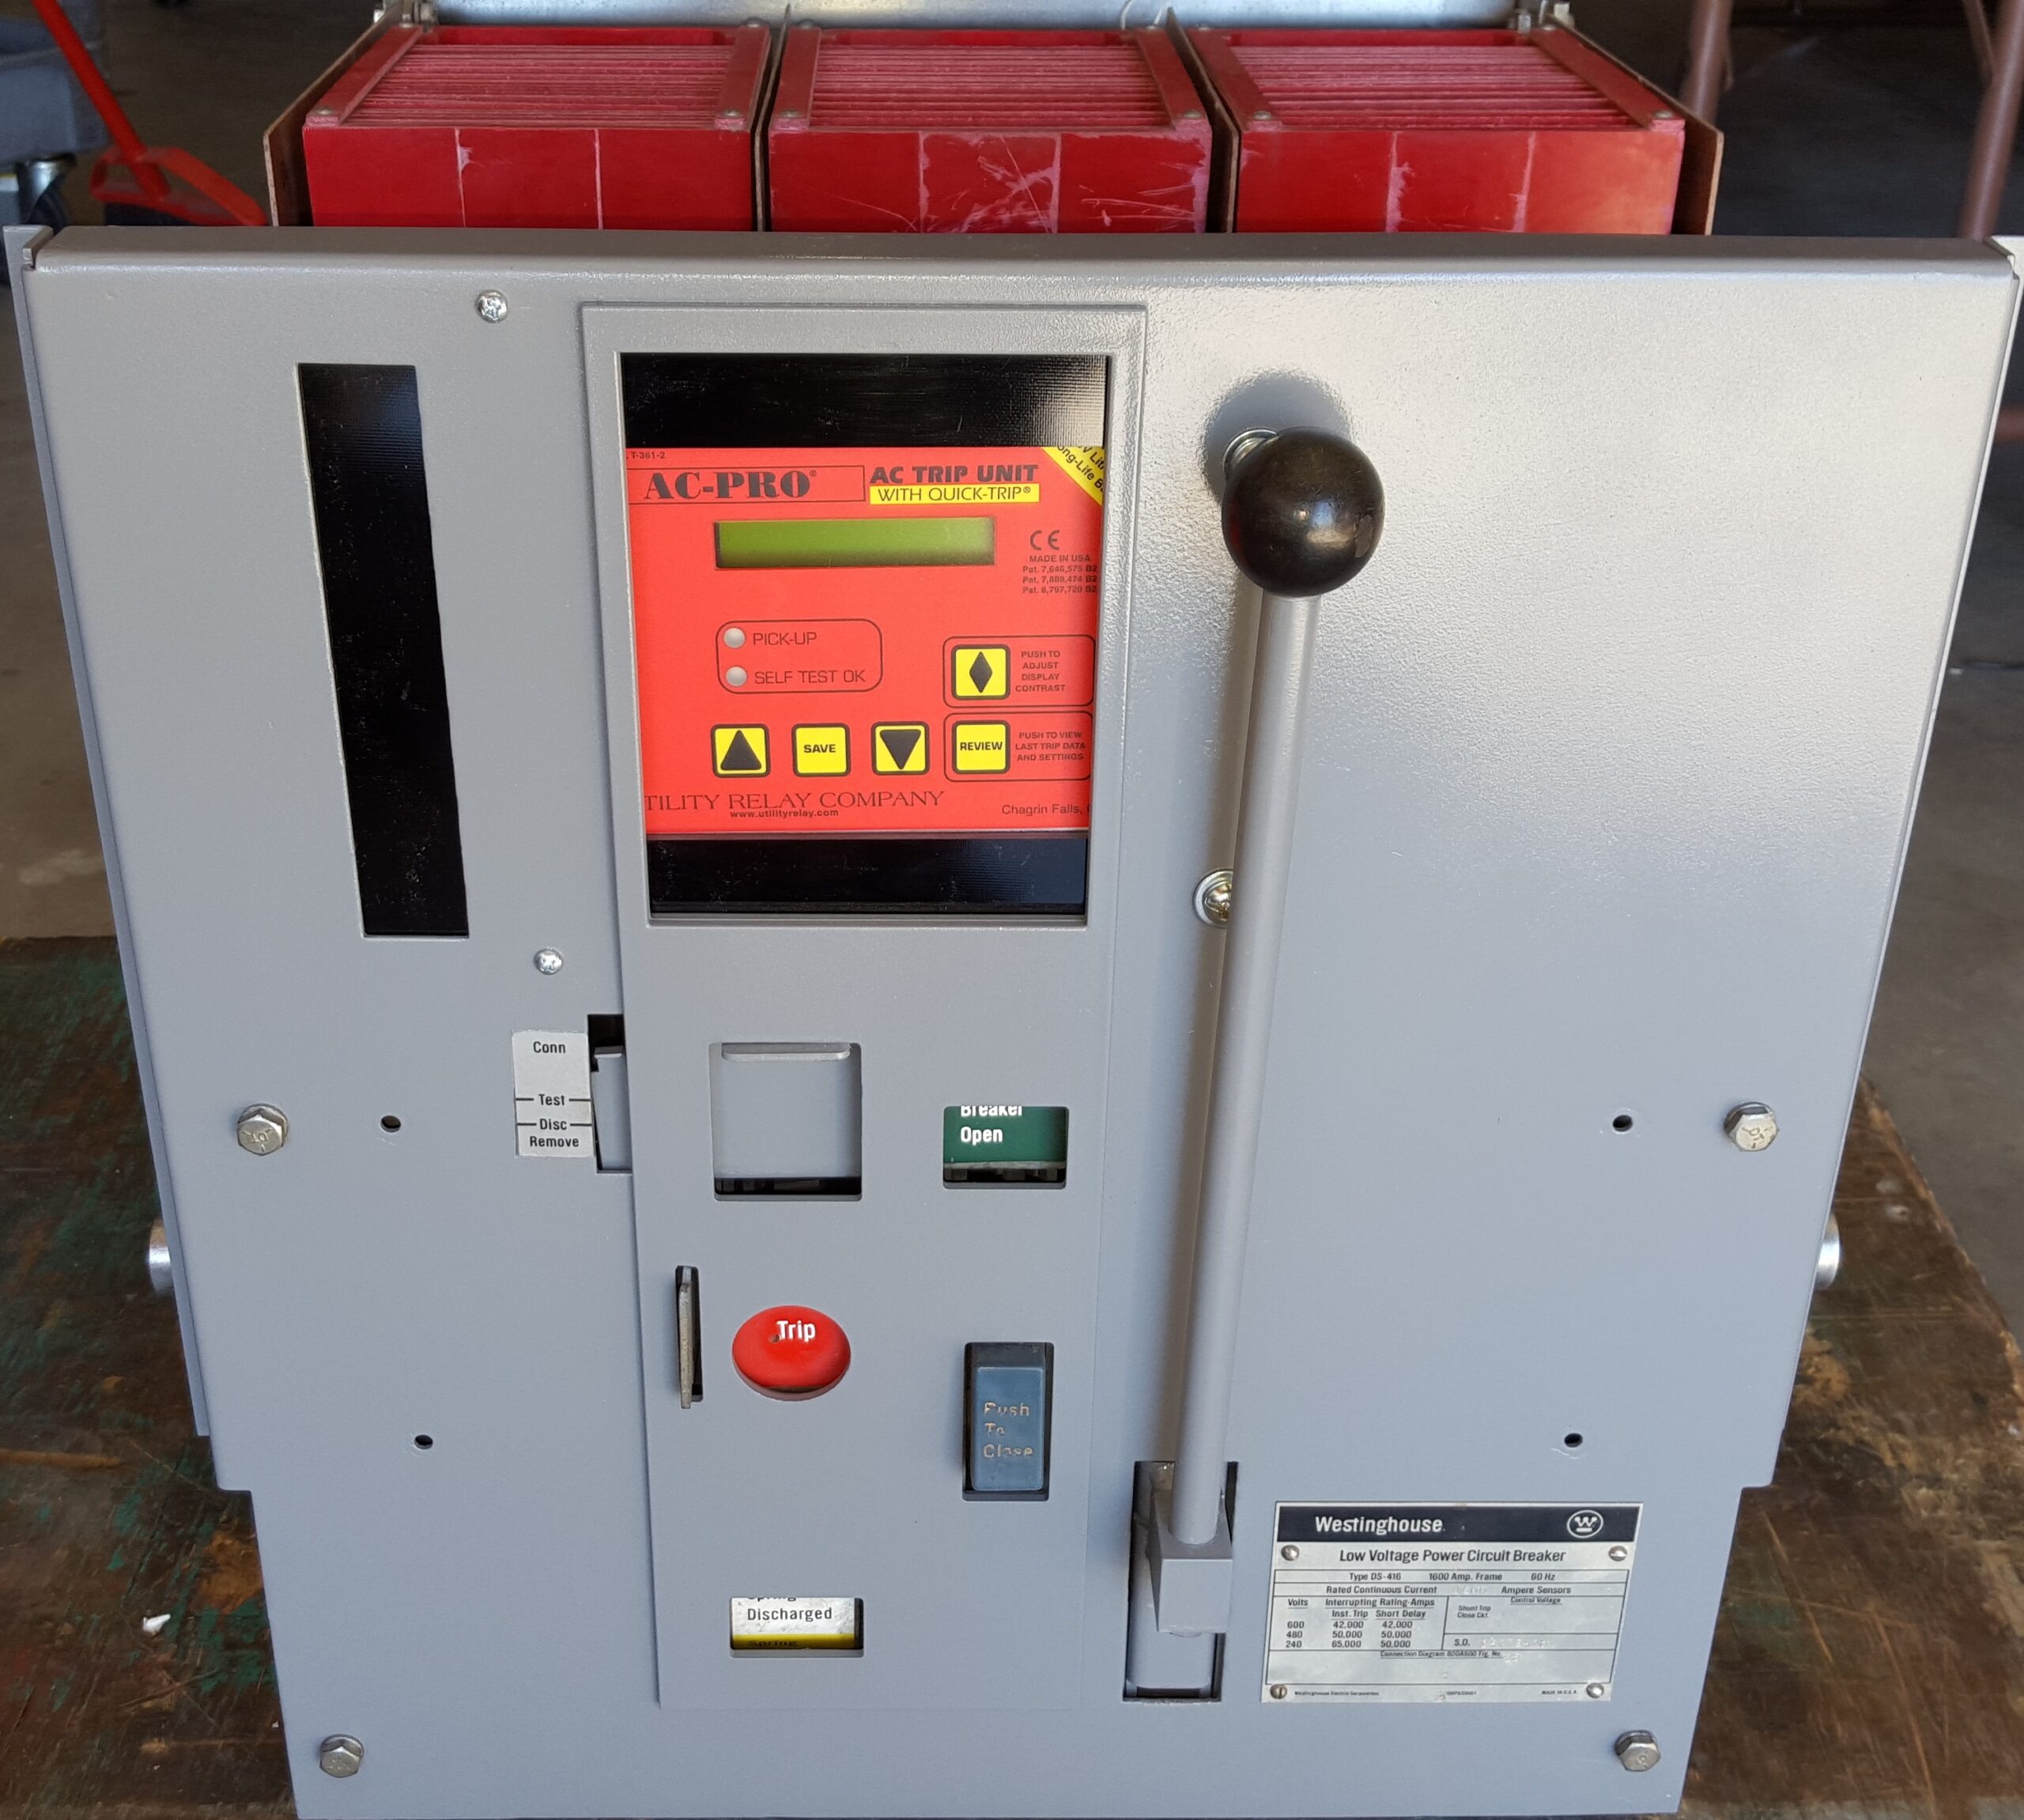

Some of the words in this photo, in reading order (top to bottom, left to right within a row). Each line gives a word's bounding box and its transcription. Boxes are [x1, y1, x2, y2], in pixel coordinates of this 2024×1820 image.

[1057, 447, 1094, 480] ong-Life
[870, 466, 904, 484] AC
[912, 466, 968, 483] TRIP
[977, 465, 1038, 481] UNIT
[878, 488, 922, 501] WITH
[753, 632, 817, 645] PICK-UP
[754, 671, 793, 684] SELF
[798, 670, 838, 683] TEST
[844, 670, 866, 682] OK
[803, 744, 836, 753] SAVE
[960, 742, 1003, 751] REVIEW
[644, 795, 720, 811] TILITY
[728, 792, 811, 810] RELAY
[819, 791, 944, 808] COMPANY
[731, 808, 839, 819] www.utilityrelay.com
[1002, 803, 1048, 816] Chagrin
[1052, 803, 1082, 814] Falls,
[533, 1041, 566, 1053] Conn
[538, 1094, 565, 1105] Test
[539, 1118, 567, 1130] Disc
[530, 1136, 580, 1147] Remove
[961, 1126, 1003, 1146] Open
[776, 1320, 816, 1342] Trip
[984, 1402, 1030, 1417] Push
[984, 1422, 1006, 1437] To
[1315, 1516, 1444, 1535] Westinghouse
[1339, 1550, 1365, 1561] Low
[1369, 1550, 1419, 1564] Voltage
[1422, 1550, 1465, 1561] Power
[1467, 1550, 1511, 1561] Circuit
[1512, 1550, 1566, 1561] Breaker
[1349, 1573, 1368, 1581] Type
[1451, 1573, 1473, 1581] Amp.
[1501, 1586, 1534, 1595] Ampere
[1325, 1599, 1377, 1607] Interrupting
[747, 1607, 833, 1622] Discharged
[1353, 1610, 1369, 1618] Trip
[1402, 1610, 1426, 1618] Delay
